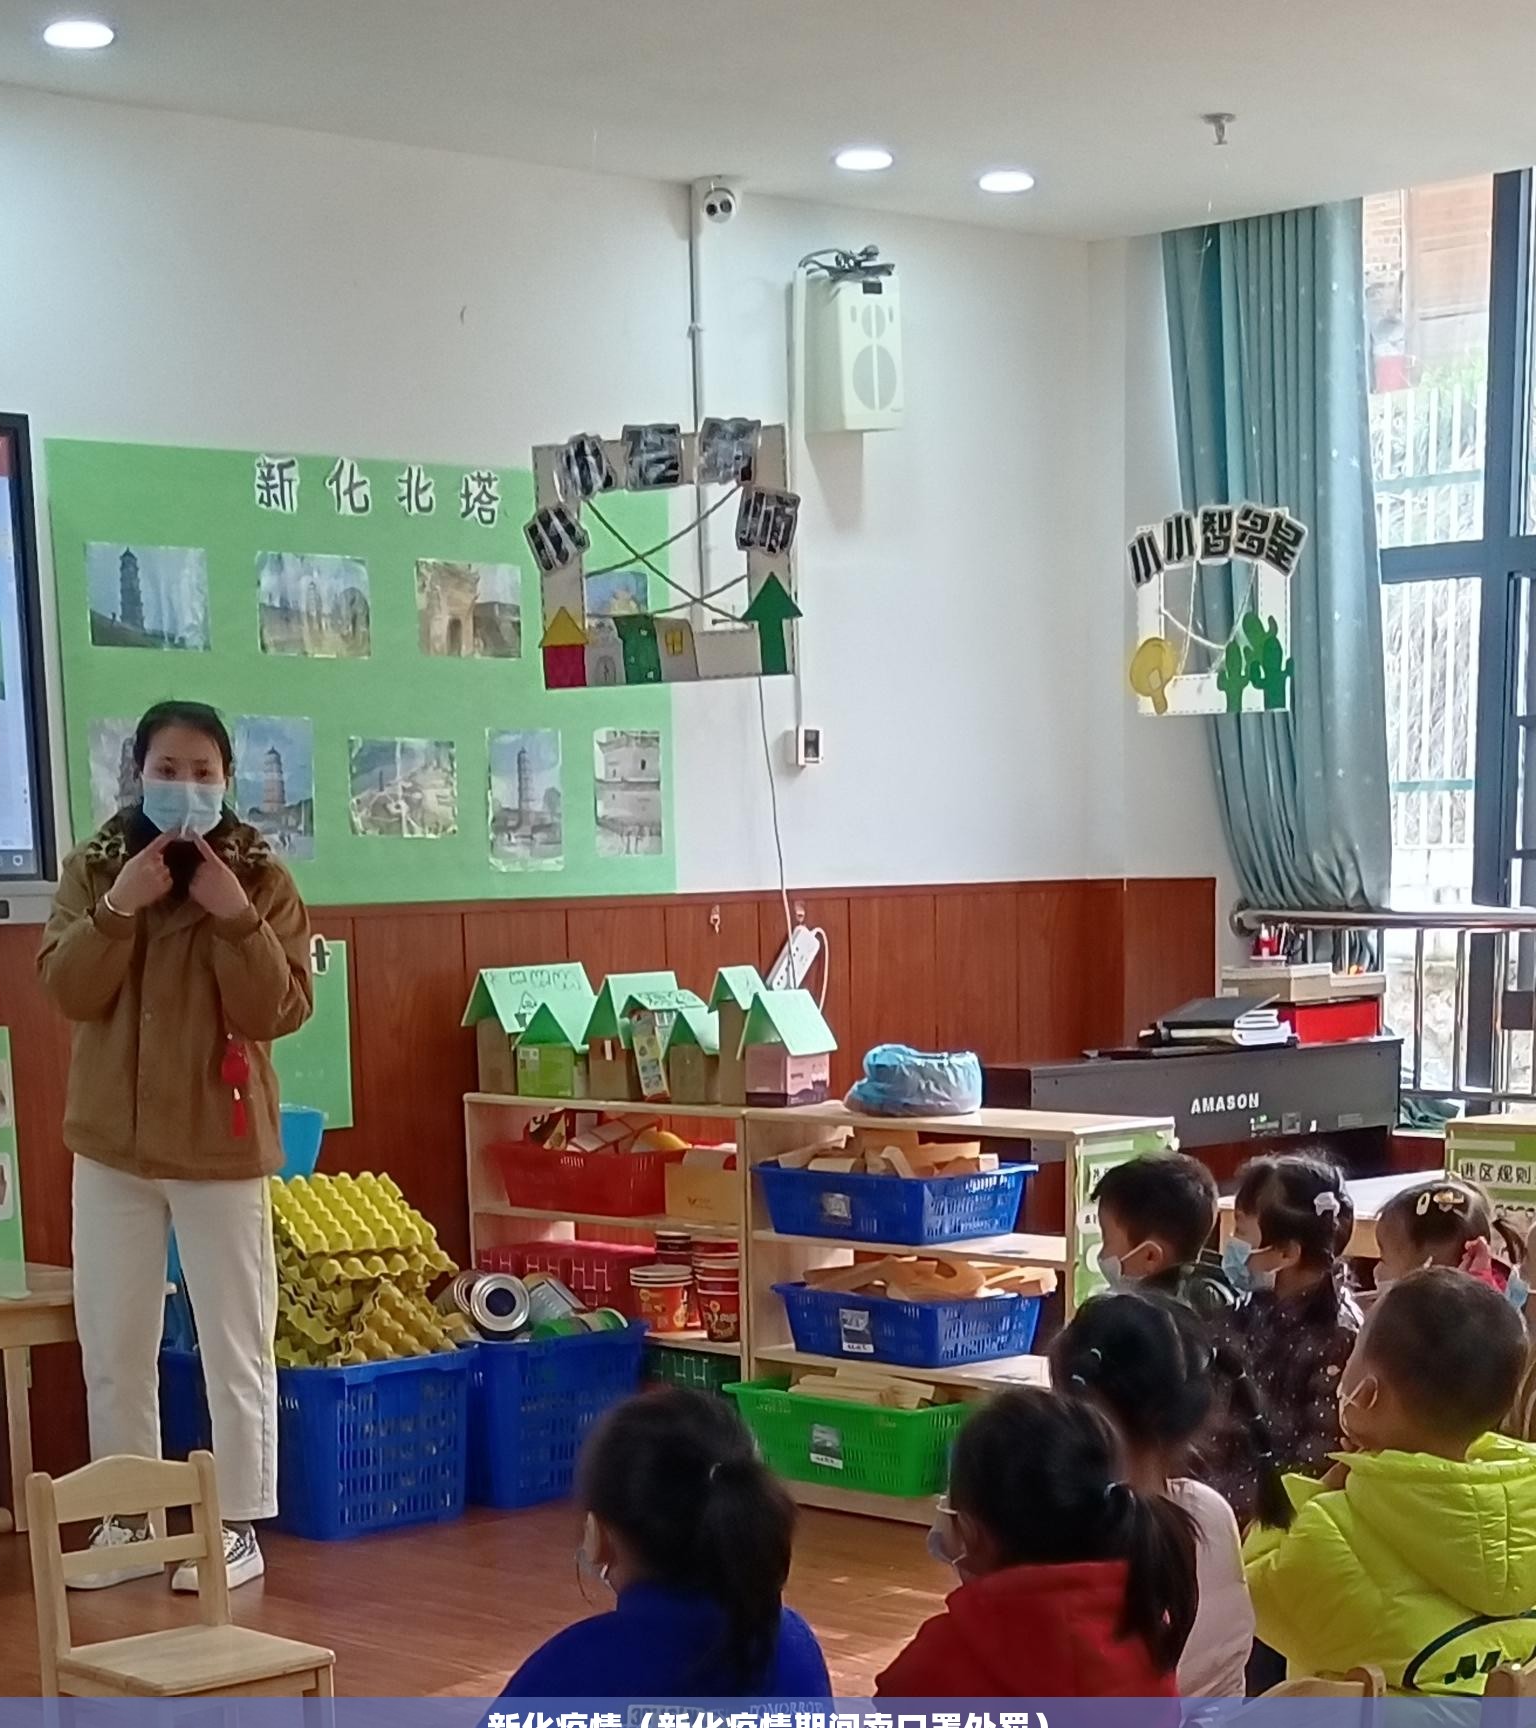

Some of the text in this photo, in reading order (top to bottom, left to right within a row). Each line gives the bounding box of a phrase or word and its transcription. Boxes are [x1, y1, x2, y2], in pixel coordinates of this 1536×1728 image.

[257, 459, 500, 525] 新化北塔
[1191, 1093, 1259, 1114] AMASON
